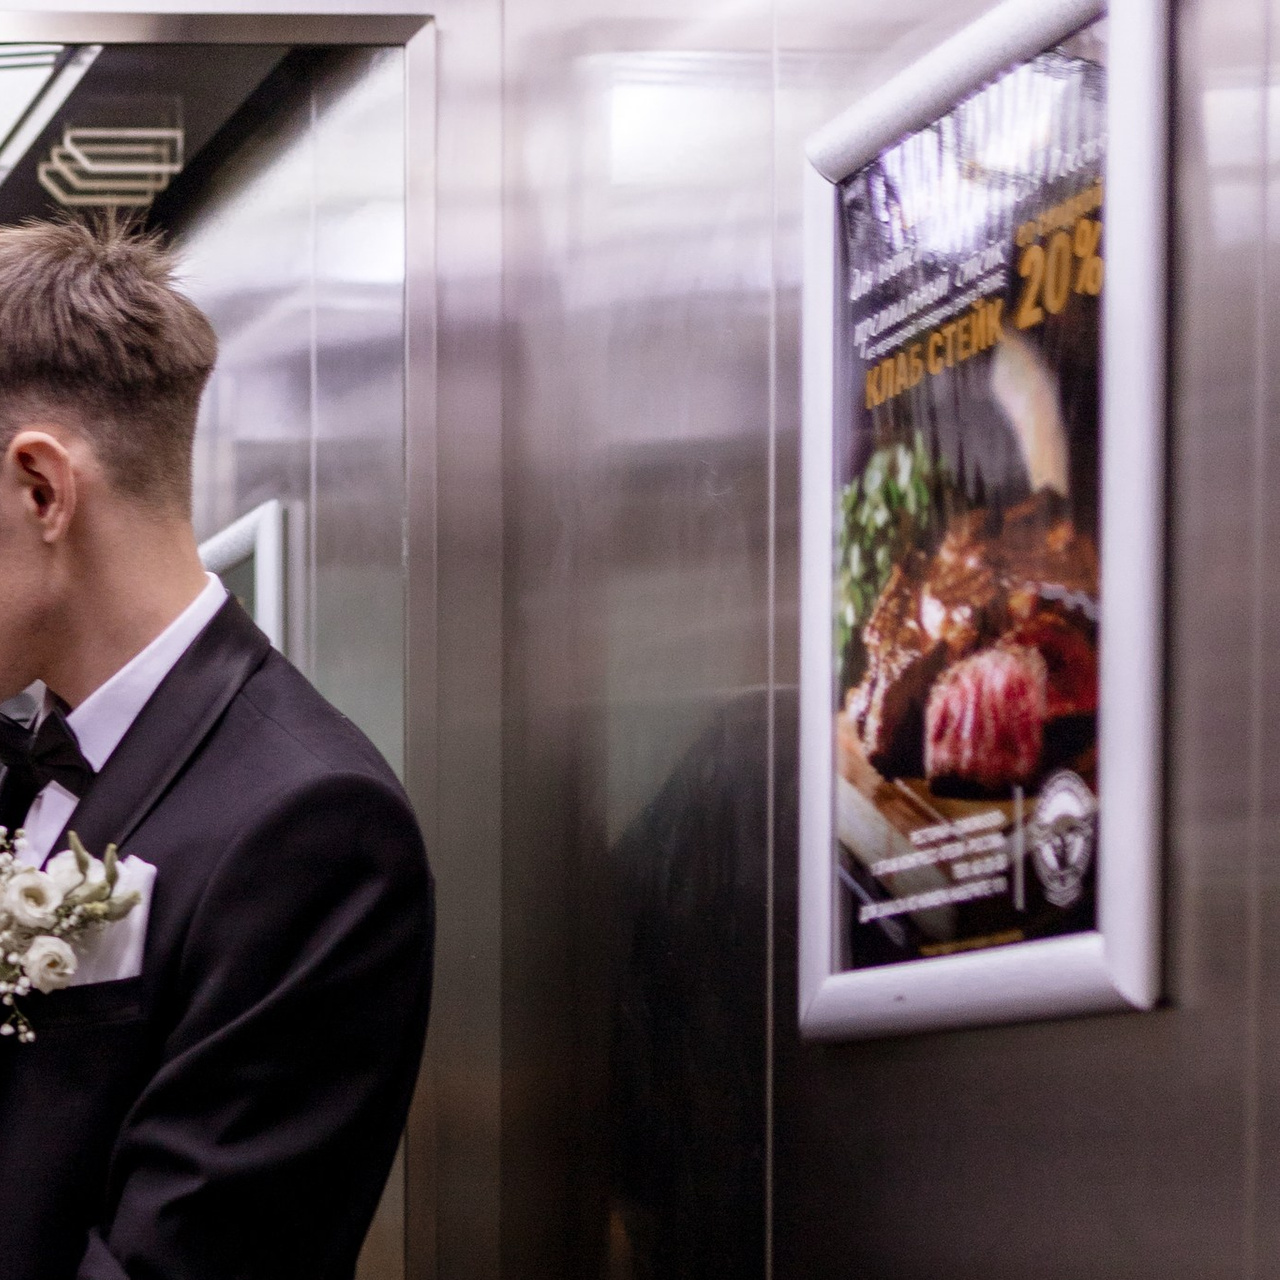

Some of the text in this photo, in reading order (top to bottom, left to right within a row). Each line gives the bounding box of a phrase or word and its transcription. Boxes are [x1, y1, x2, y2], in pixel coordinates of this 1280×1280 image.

[1016, 219, 1104, 329] 20%
[865, 344, 924, 410] КЛАБ
[927, 298, 1005, 376] СТЕЙК
